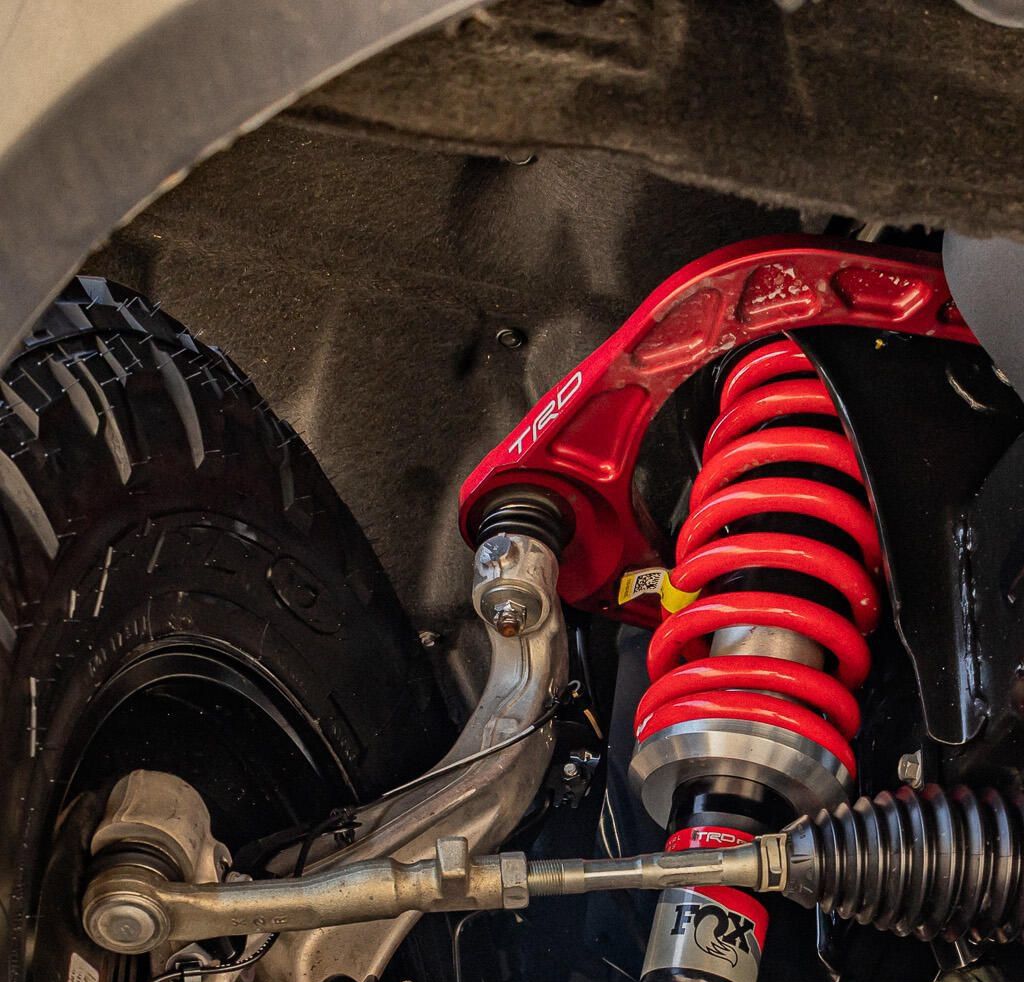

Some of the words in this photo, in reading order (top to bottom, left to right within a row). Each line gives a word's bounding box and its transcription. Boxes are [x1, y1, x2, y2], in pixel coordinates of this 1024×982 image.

[508, 371, 582, 454] TRD
[697, 832, 735, 843] TRD
[670, 904, 756, 962] FOX
